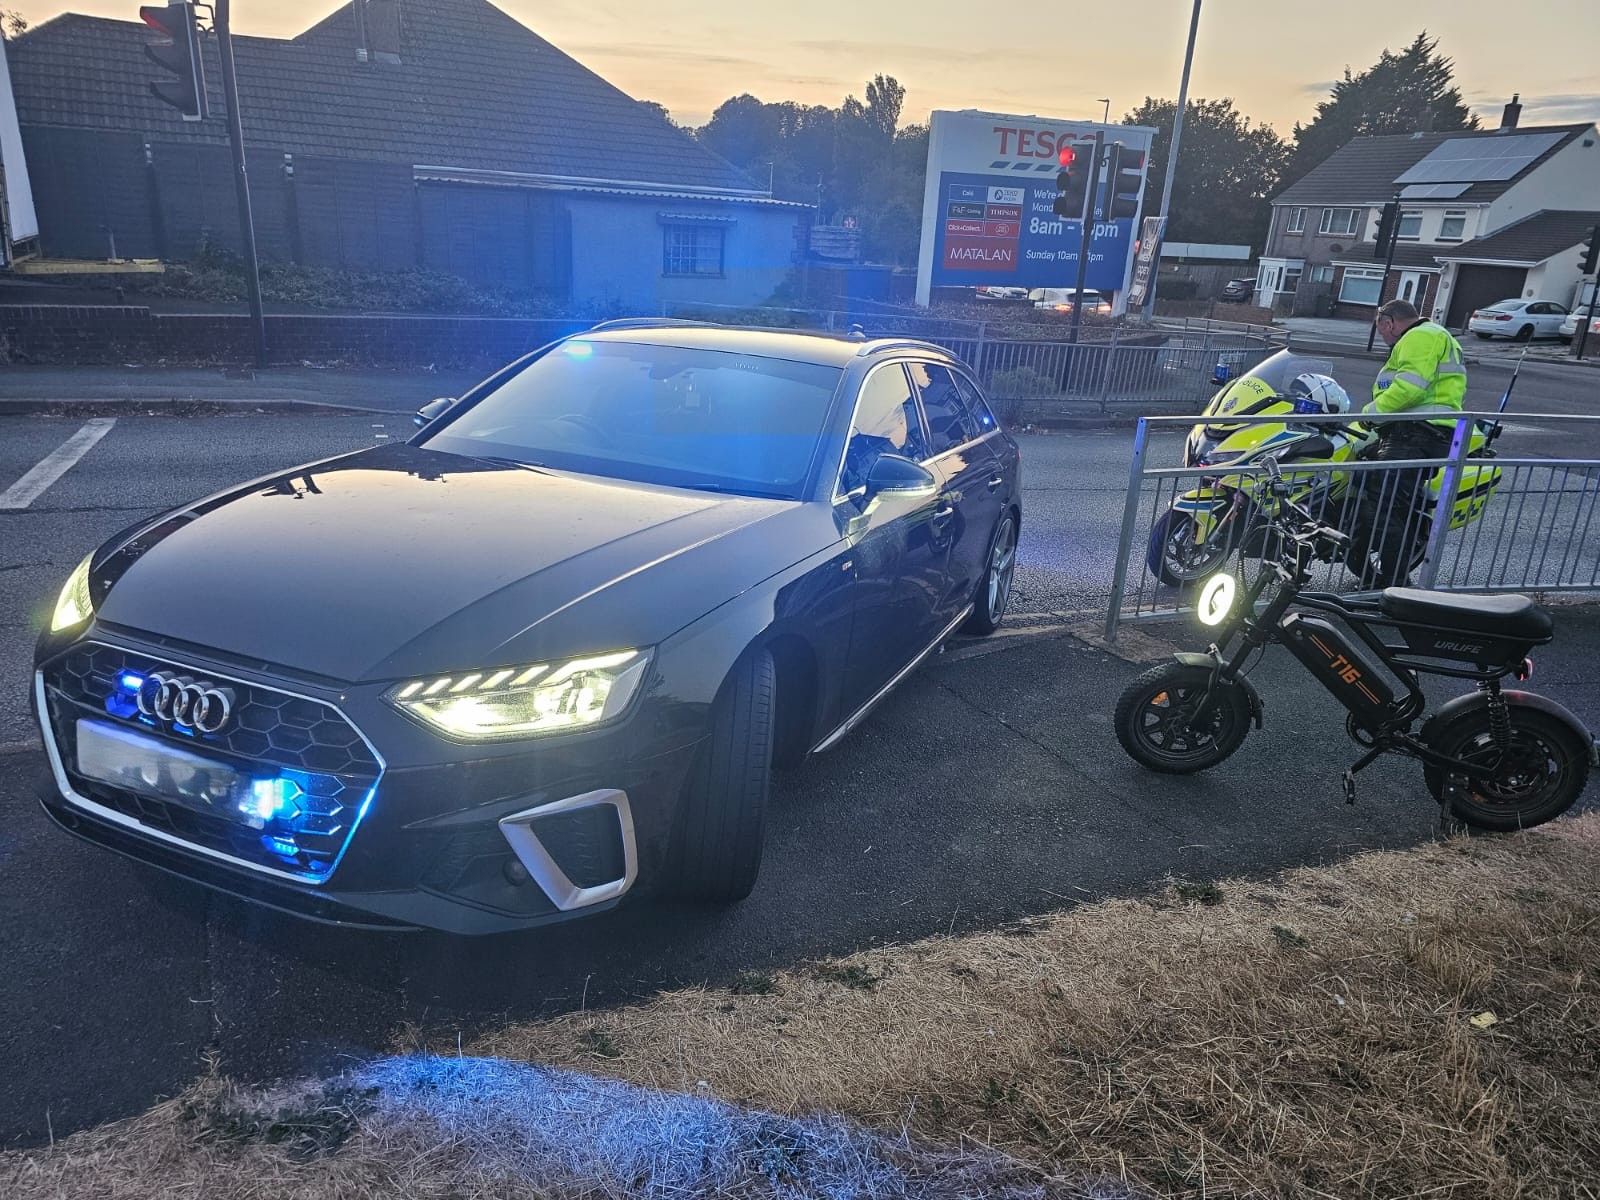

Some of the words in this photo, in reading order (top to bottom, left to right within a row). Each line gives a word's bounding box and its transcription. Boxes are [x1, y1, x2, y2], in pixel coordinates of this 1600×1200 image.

[993, 127, 1096, 159] TESC
[1033, 189, 1057, 199] We're
[1032, 202, 1054, 213] Mond
[1029, 217, 1063, 235] 8am
[950, 247, 1012, 262] MATALAN
[1026, 249, 1056, 262] Sunday
[1057, 250, 1078, 261] 10am
[1330, 653, 1362, 684] T16
